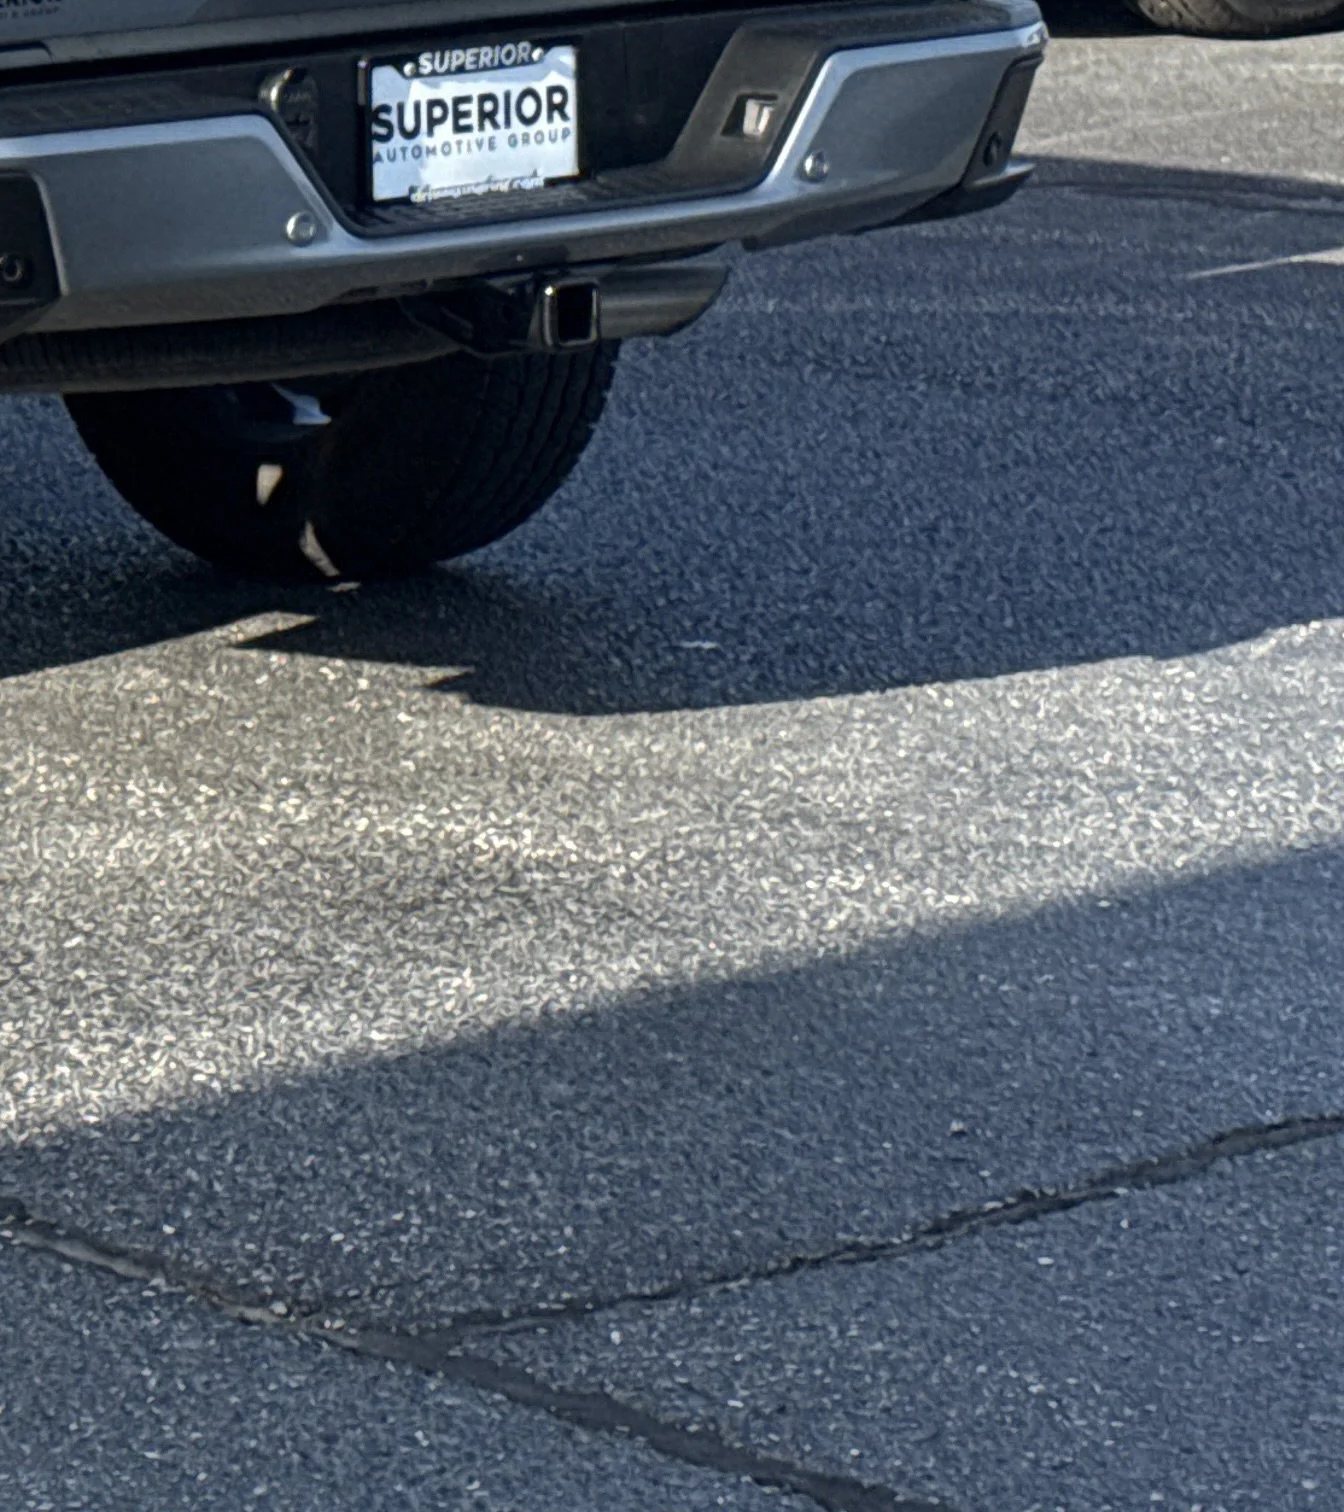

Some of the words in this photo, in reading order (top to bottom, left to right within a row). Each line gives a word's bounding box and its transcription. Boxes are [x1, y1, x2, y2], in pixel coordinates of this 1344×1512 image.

[418, 41, 533, 75] SUPERIOR
[372, 84, 571, 144] SUPERIOR
[373, 134, 497, 164] AUTOMOTIVE
[507, 126, 571, 150] GROUP
